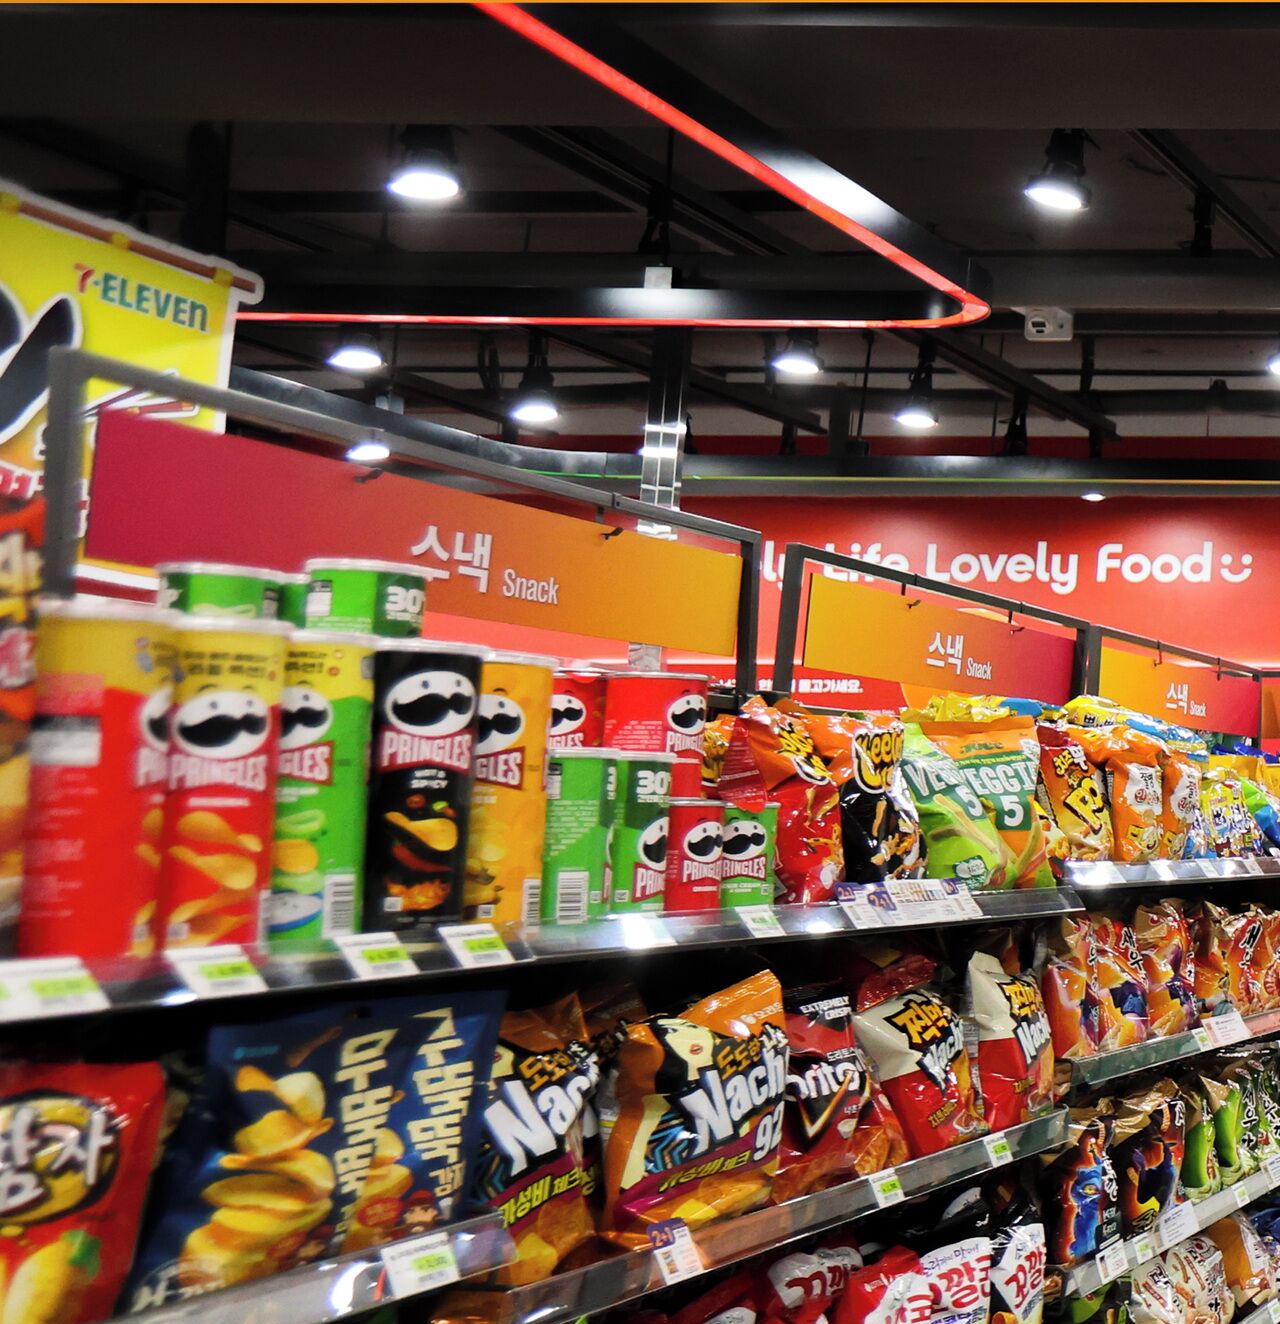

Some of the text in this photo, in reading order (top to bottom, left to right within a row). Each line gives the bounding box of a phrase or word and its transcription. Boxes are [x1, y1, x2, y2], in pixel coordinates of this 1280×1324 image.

[411, 523, 560, 606] 스낵 Snack
[926, 541, 1079, 595] Lovely
[1096, 541, 1213, 583] Food
[926, 631, 993, 680] 스낵 Snack
[1166, 681, 1207, 717] 스낵 Snack
[382, 732, 472, 771] PRINGLES
[410, 778, 449, 789] SPICY
[722, 857, 767, 879] RINGLES
[800, 995, 850, 1015] EXTREMELY
[681, 1048, 787, 1155] Nach
